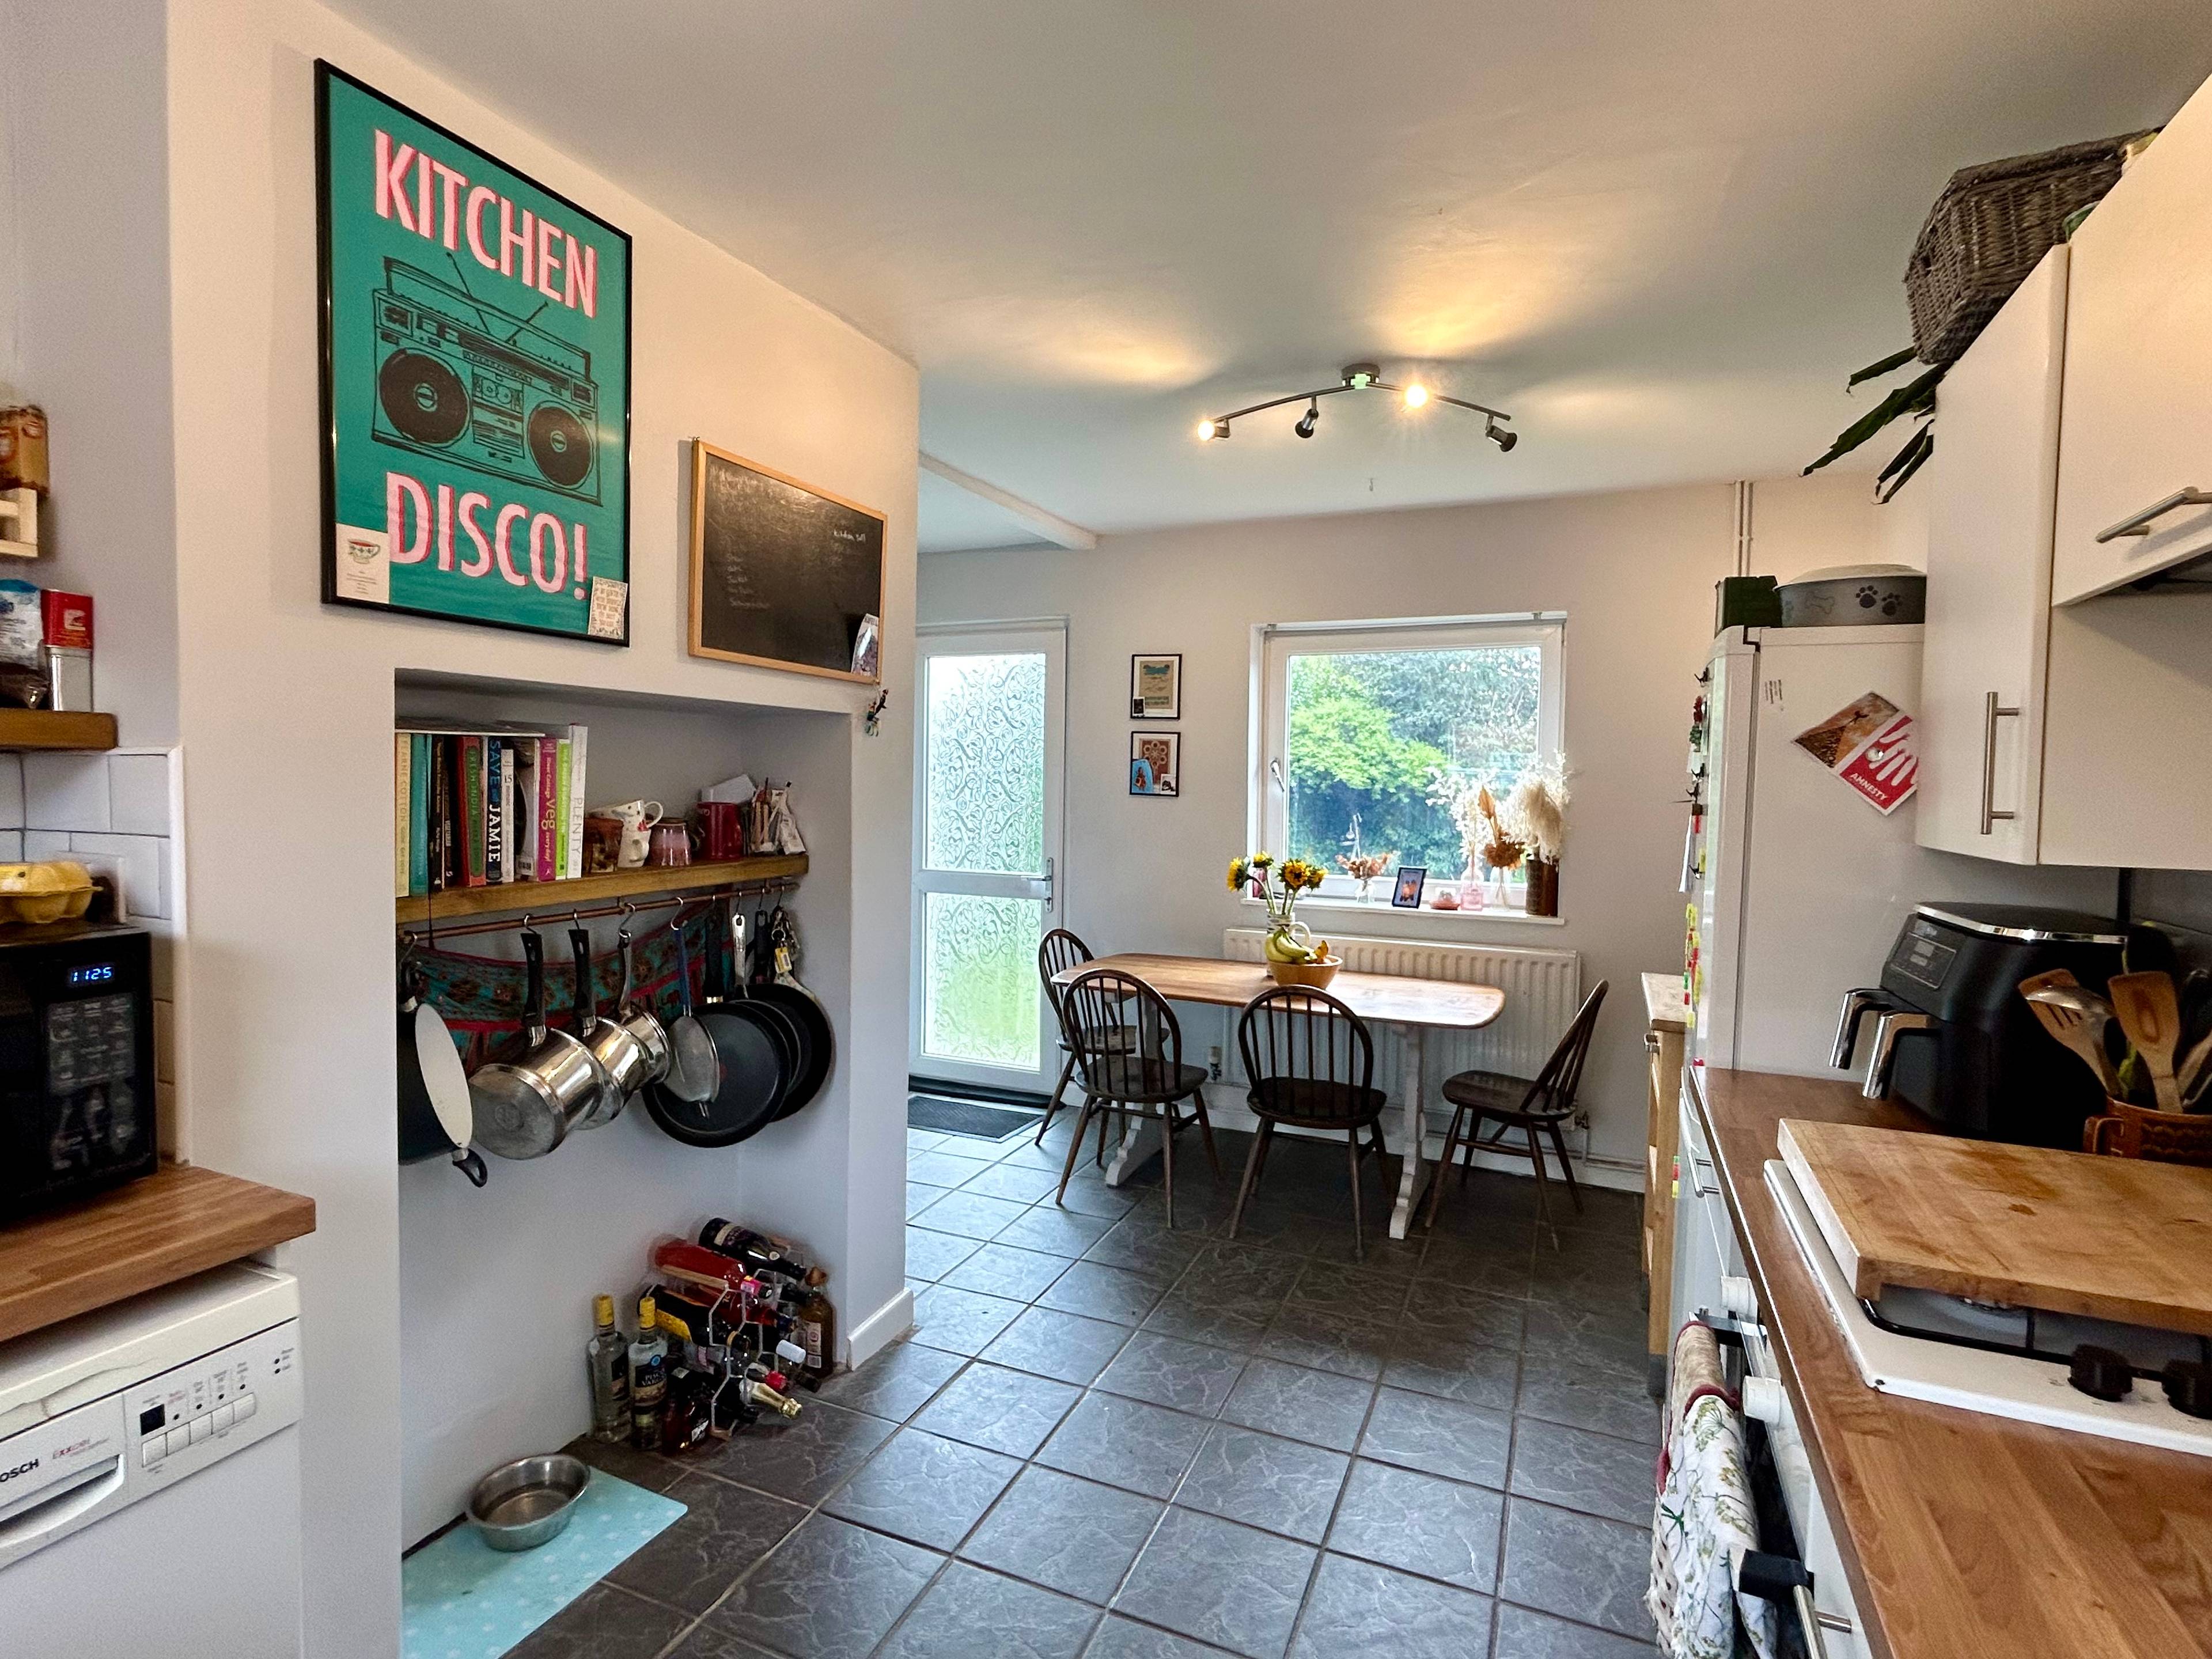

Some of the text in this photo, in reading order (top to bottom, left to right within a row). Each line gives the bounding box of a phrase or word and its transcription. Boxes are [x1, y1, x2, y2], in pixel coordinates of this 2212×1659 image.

[374, 129, 597, 318] KITCHEN
[386, 471, 589, 600] DISCO!
[490, 740, 501, 785] SAVE
[504, 775, 512, 783] 15
[400, 782, 408, 821] COTTON
[469, 784, 478, 816] INDIA
[1850, 772, 1888, 801] AMNESTY
[488, 804, 501, 862] JAMIE
[541, 799, 555, 830] veg
[571, 797, 583, 854] PLENTY
[0, 1458, 39, 1482] OSCH
